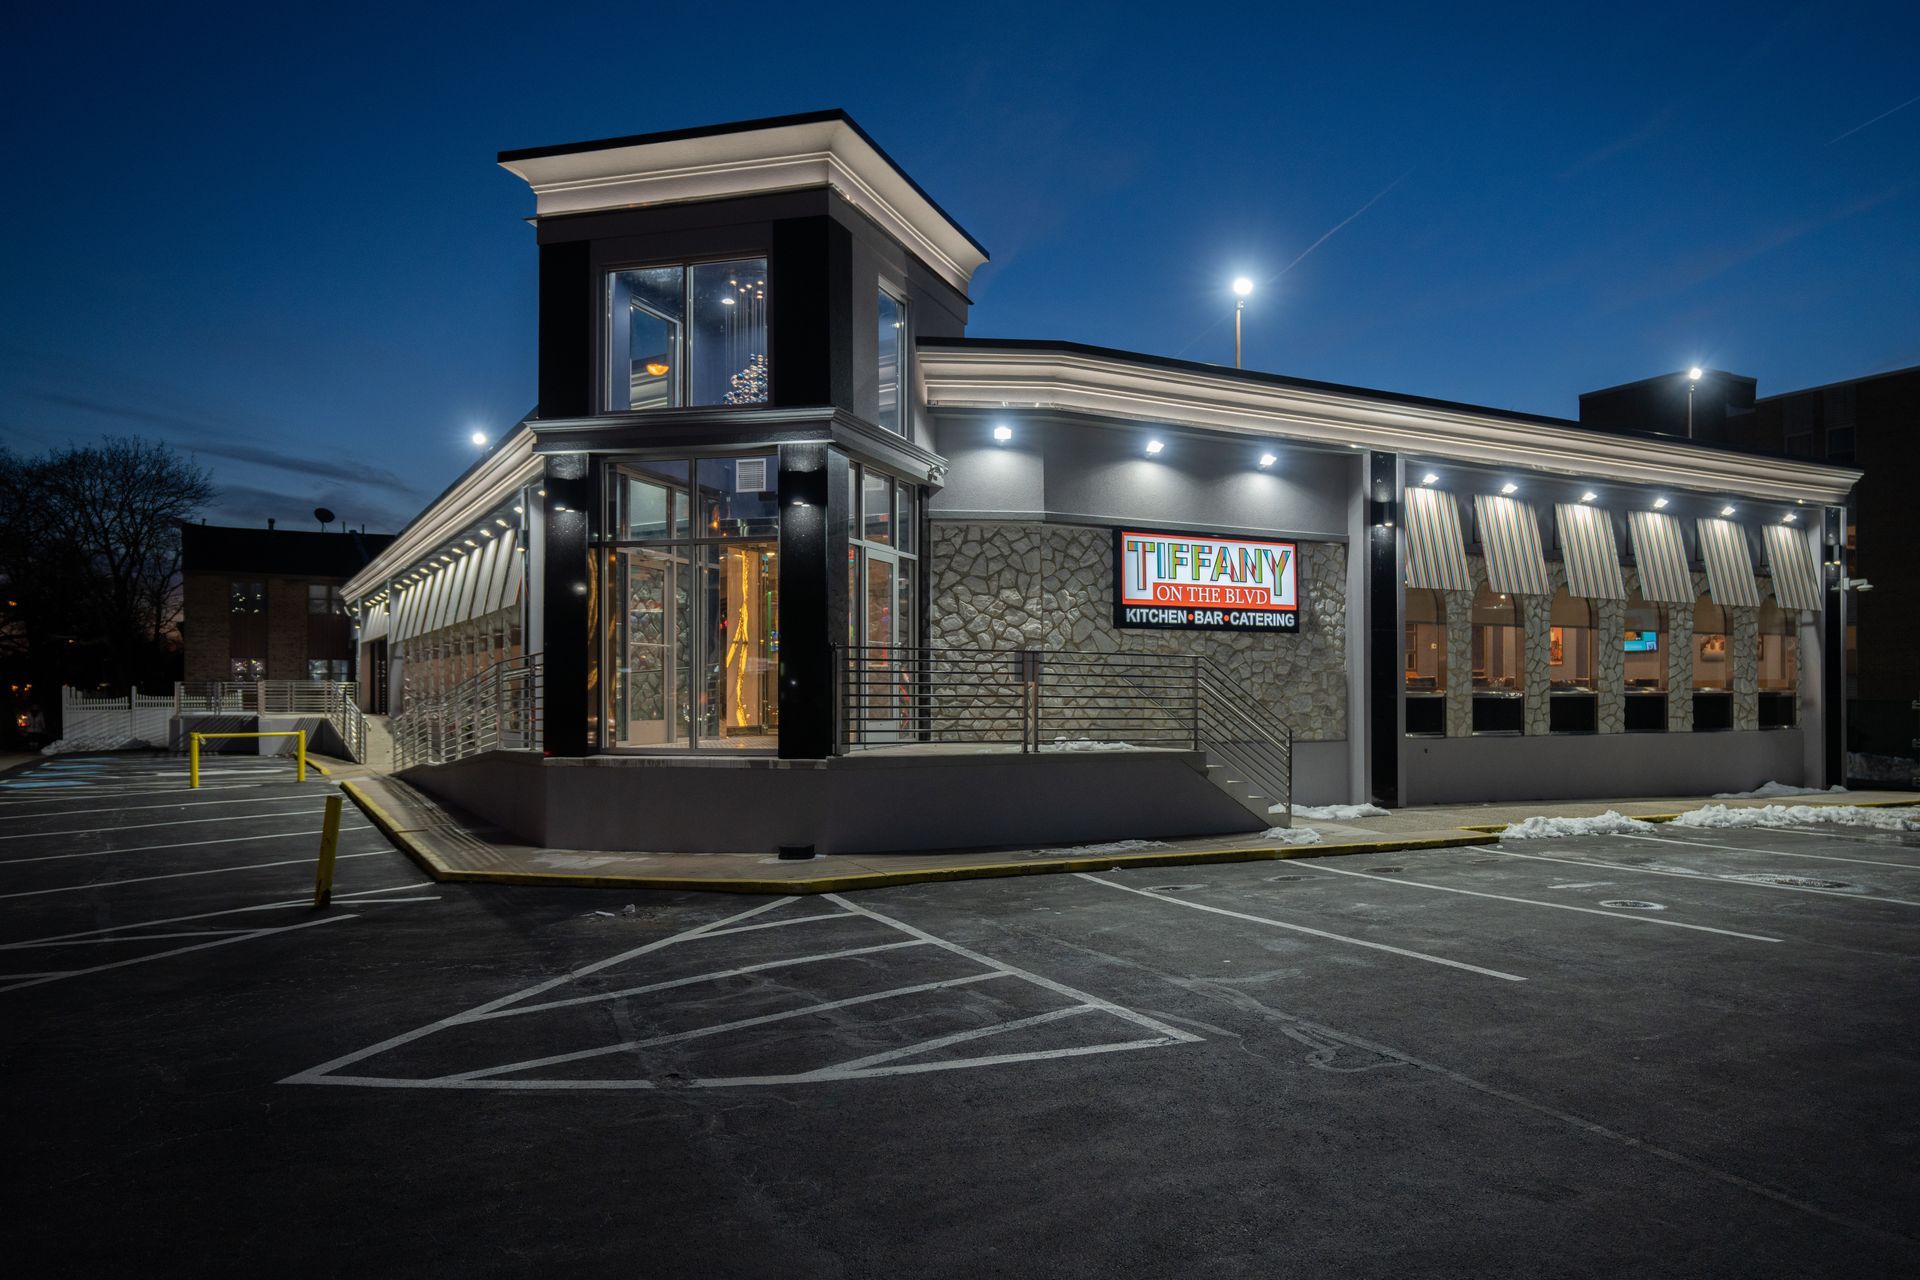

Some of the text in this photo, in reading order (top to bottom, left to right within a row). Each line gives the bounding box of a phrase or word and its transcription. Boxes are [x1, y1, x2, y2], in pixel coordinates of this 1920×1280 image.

[1127, 541, 1291, 596] TIFFANY
[1156, 586, 1268, 605] ON THE BLVD
[1126, 608, 1294, 627] KITCHEN BAR CATERING
